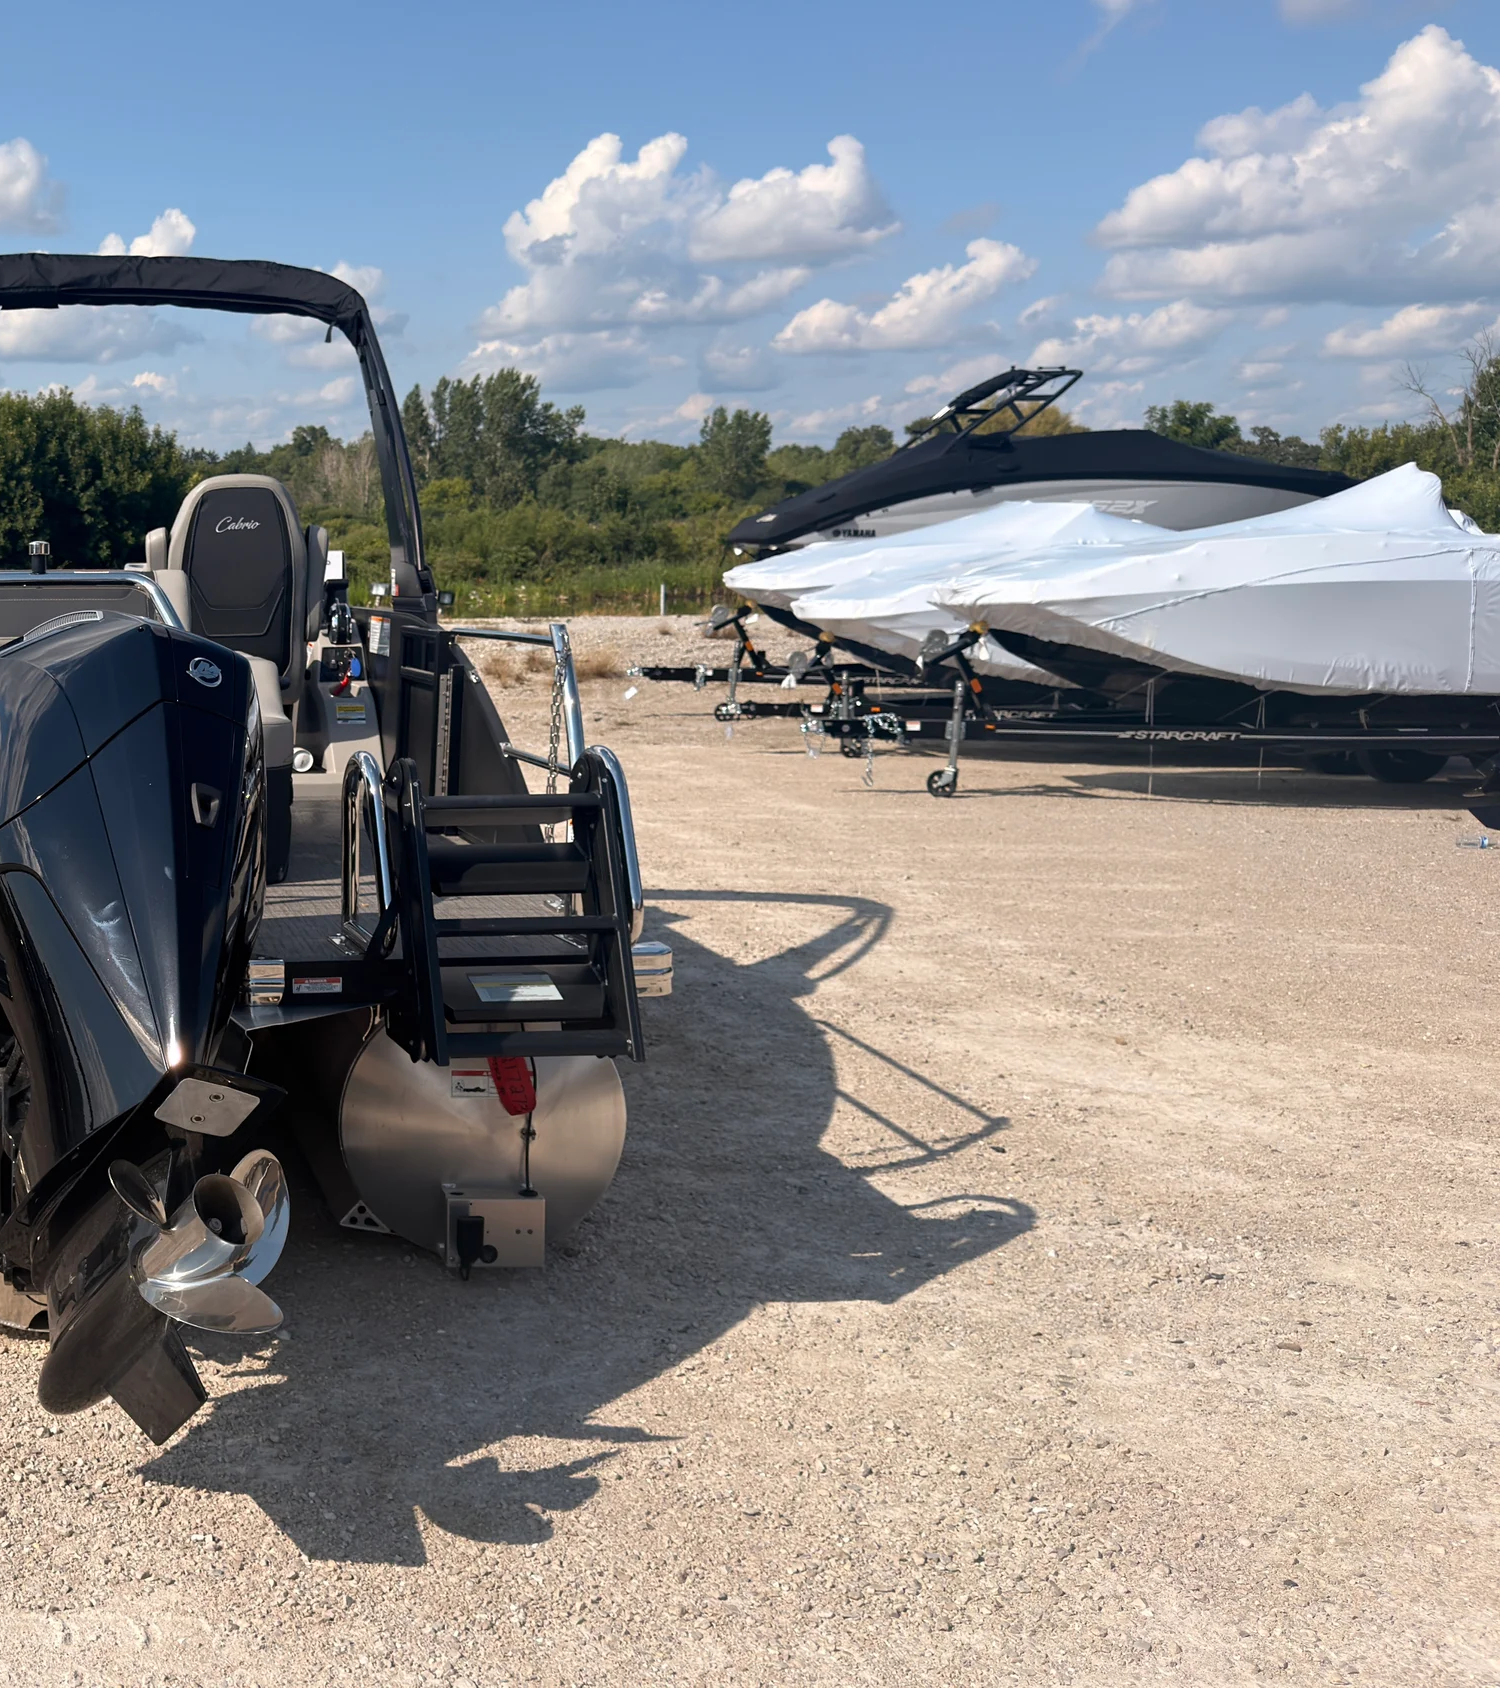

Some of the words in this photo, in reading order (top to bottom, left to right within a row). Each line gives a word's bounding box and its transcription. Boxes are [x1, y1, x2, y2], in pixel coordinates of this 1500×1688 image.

[215, 516, 261, 533] Cabrio
[842, 529, 876, 538] YAMAHA
[1134, 730, 1241, 741] STARCRAFT
